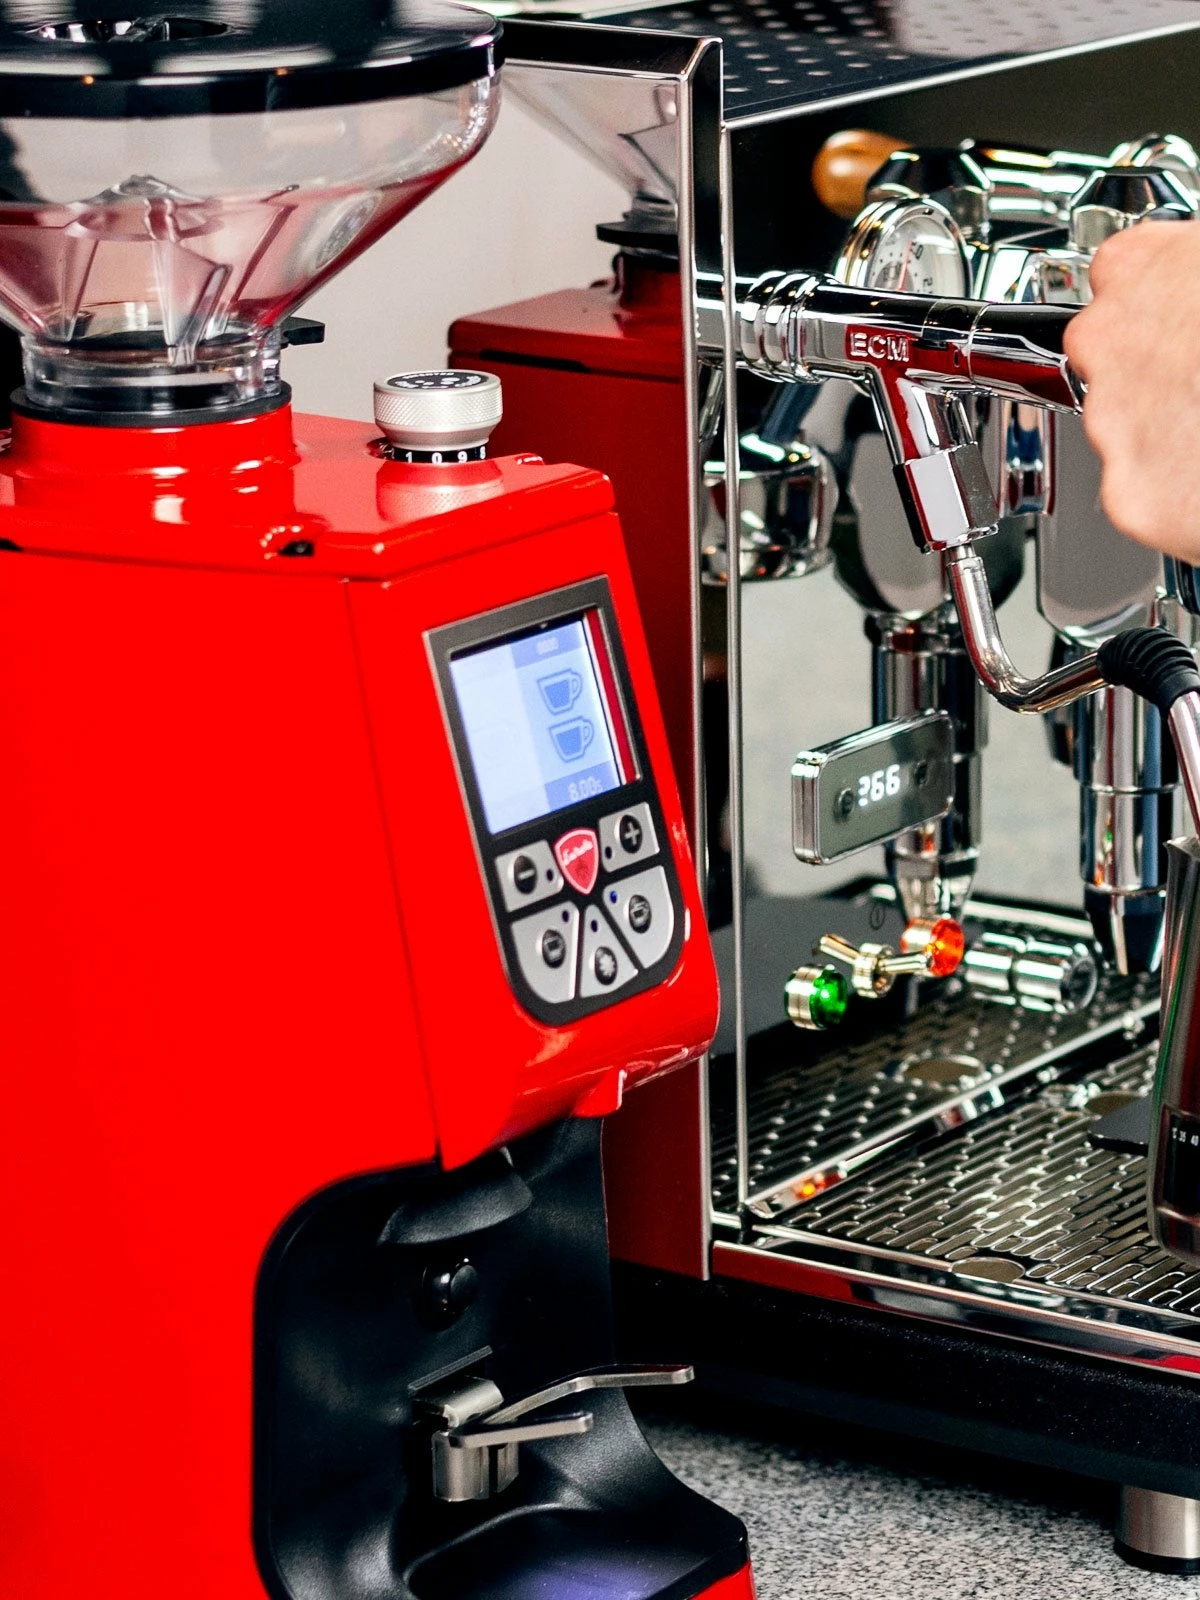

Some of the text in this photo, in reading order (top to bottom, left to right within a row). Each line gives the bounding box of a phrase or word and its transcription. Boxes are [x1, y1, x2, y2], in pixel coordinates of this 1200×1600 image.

[850, 332, 909, 362] ECM
[406, 451, 413, 464] 1
[431, 452, 443, 464] 0
[457, 451, 468, 464] 9
[1190, 1135, 1199, 1146] 40
